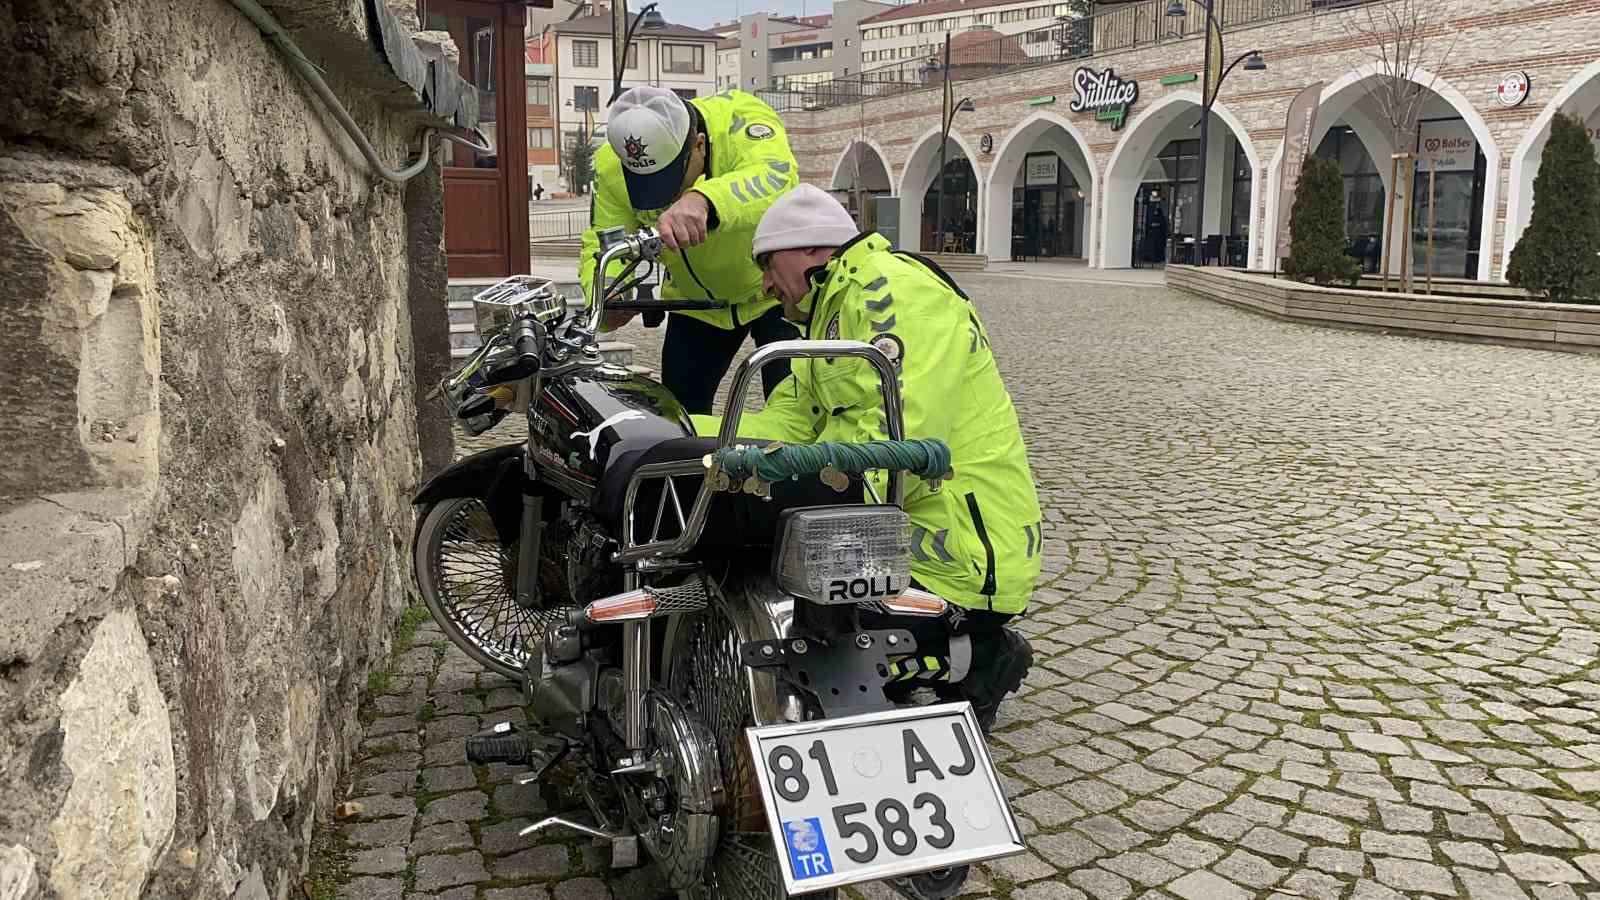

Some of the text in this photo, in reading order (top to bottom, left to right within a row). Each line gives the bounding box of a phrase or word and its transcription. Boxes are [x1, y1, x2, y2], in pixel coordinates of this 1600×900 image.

[1070, 68, 1136, 111] Sütlüce
[829, 576, 900, 600] ROLL
[769, 723, 975, 802] 81 AJ
[832, 792, 954, 863] 583
[797, 853, 828, 875] TR
